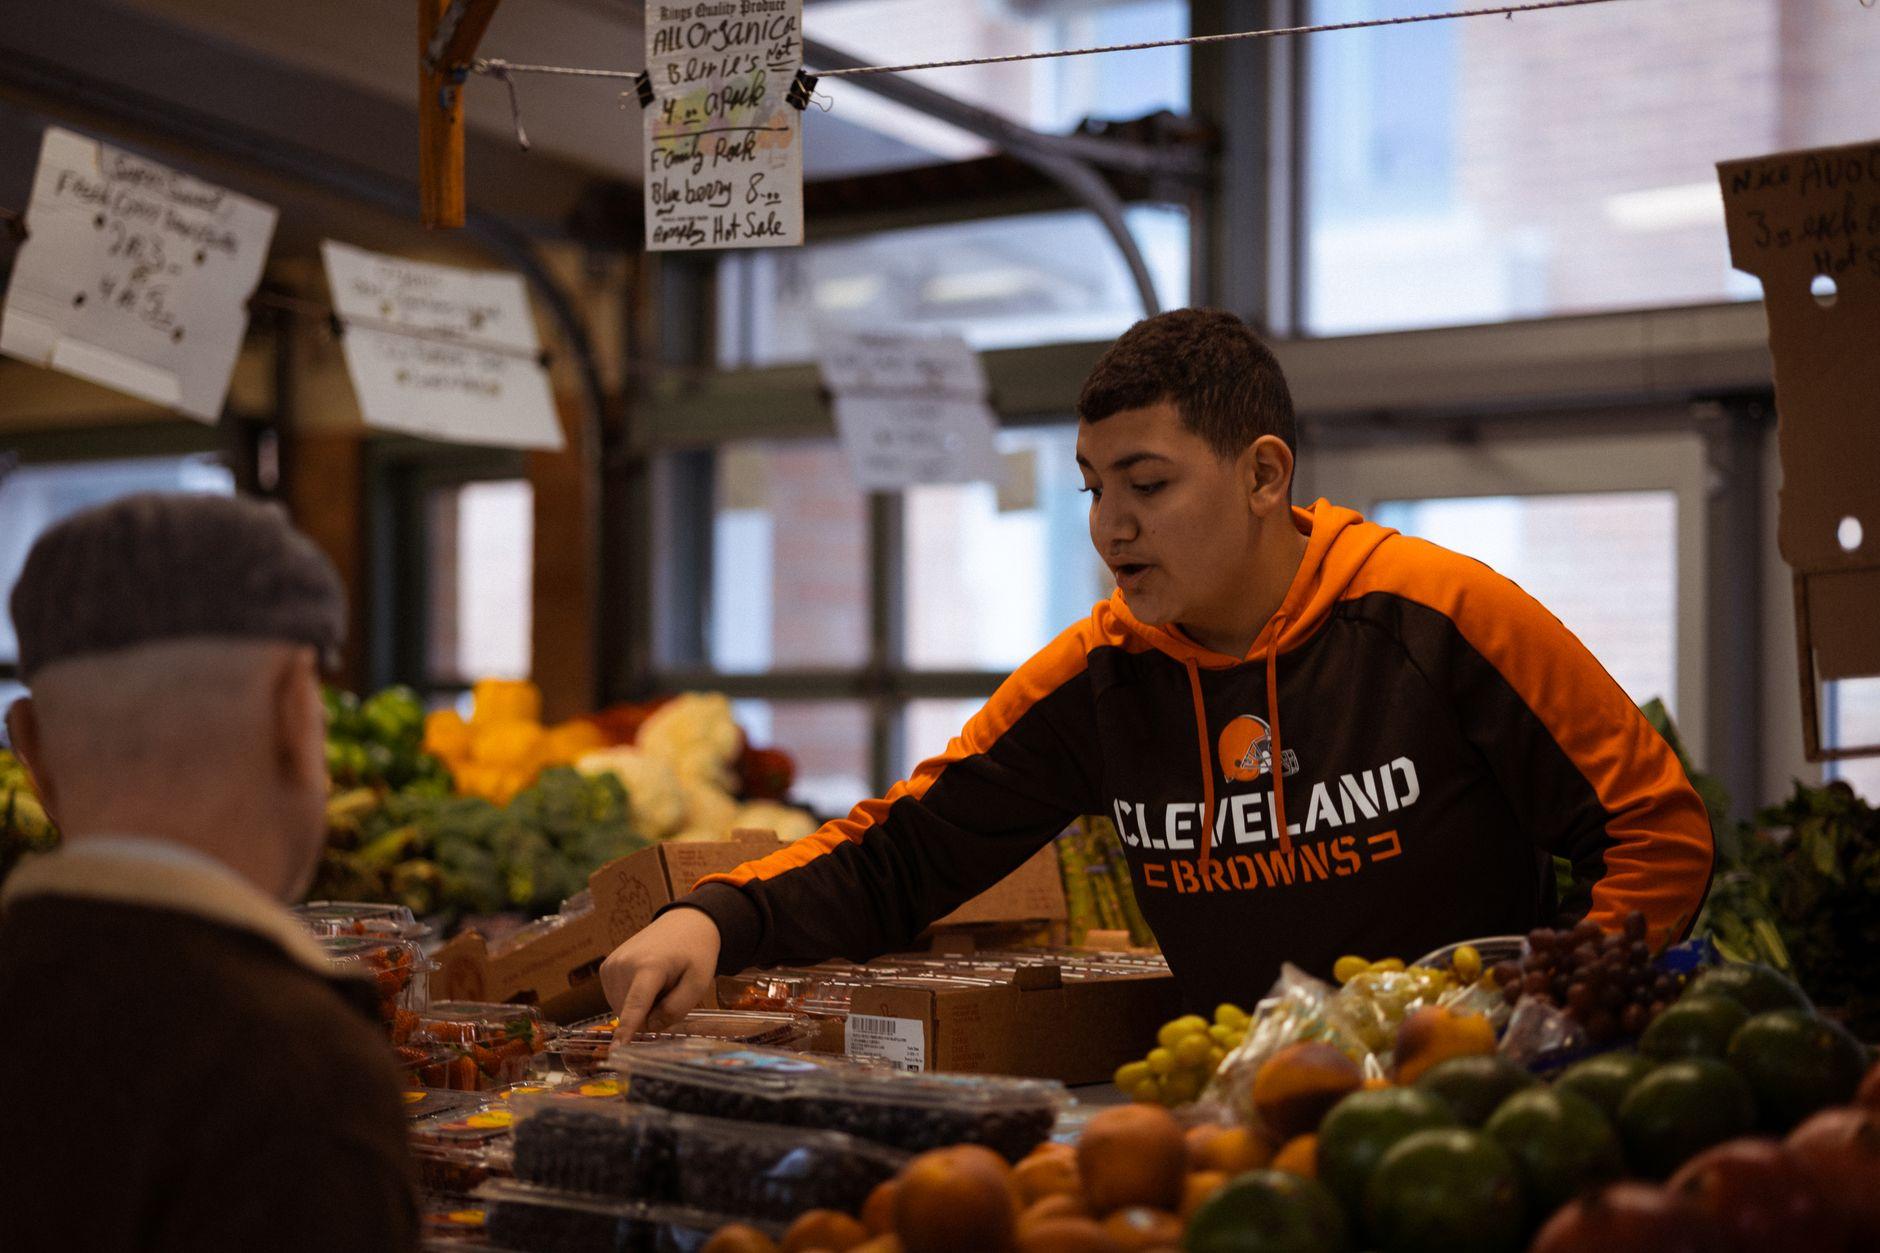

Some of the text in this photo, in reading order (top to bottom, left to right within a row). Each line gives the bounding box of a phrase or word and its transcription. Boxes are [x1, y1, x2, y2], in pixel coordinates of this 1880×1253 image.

[695, 2, 736, 18] Quality
[740, 0, 786, 16] Produce
[653, 26, 683, 55] All
[743, 210, 787, 239] Sale
[1113, 756, 1420, 850] CLEVELAND
[1170, 835, 1362, 894] BROWNS
